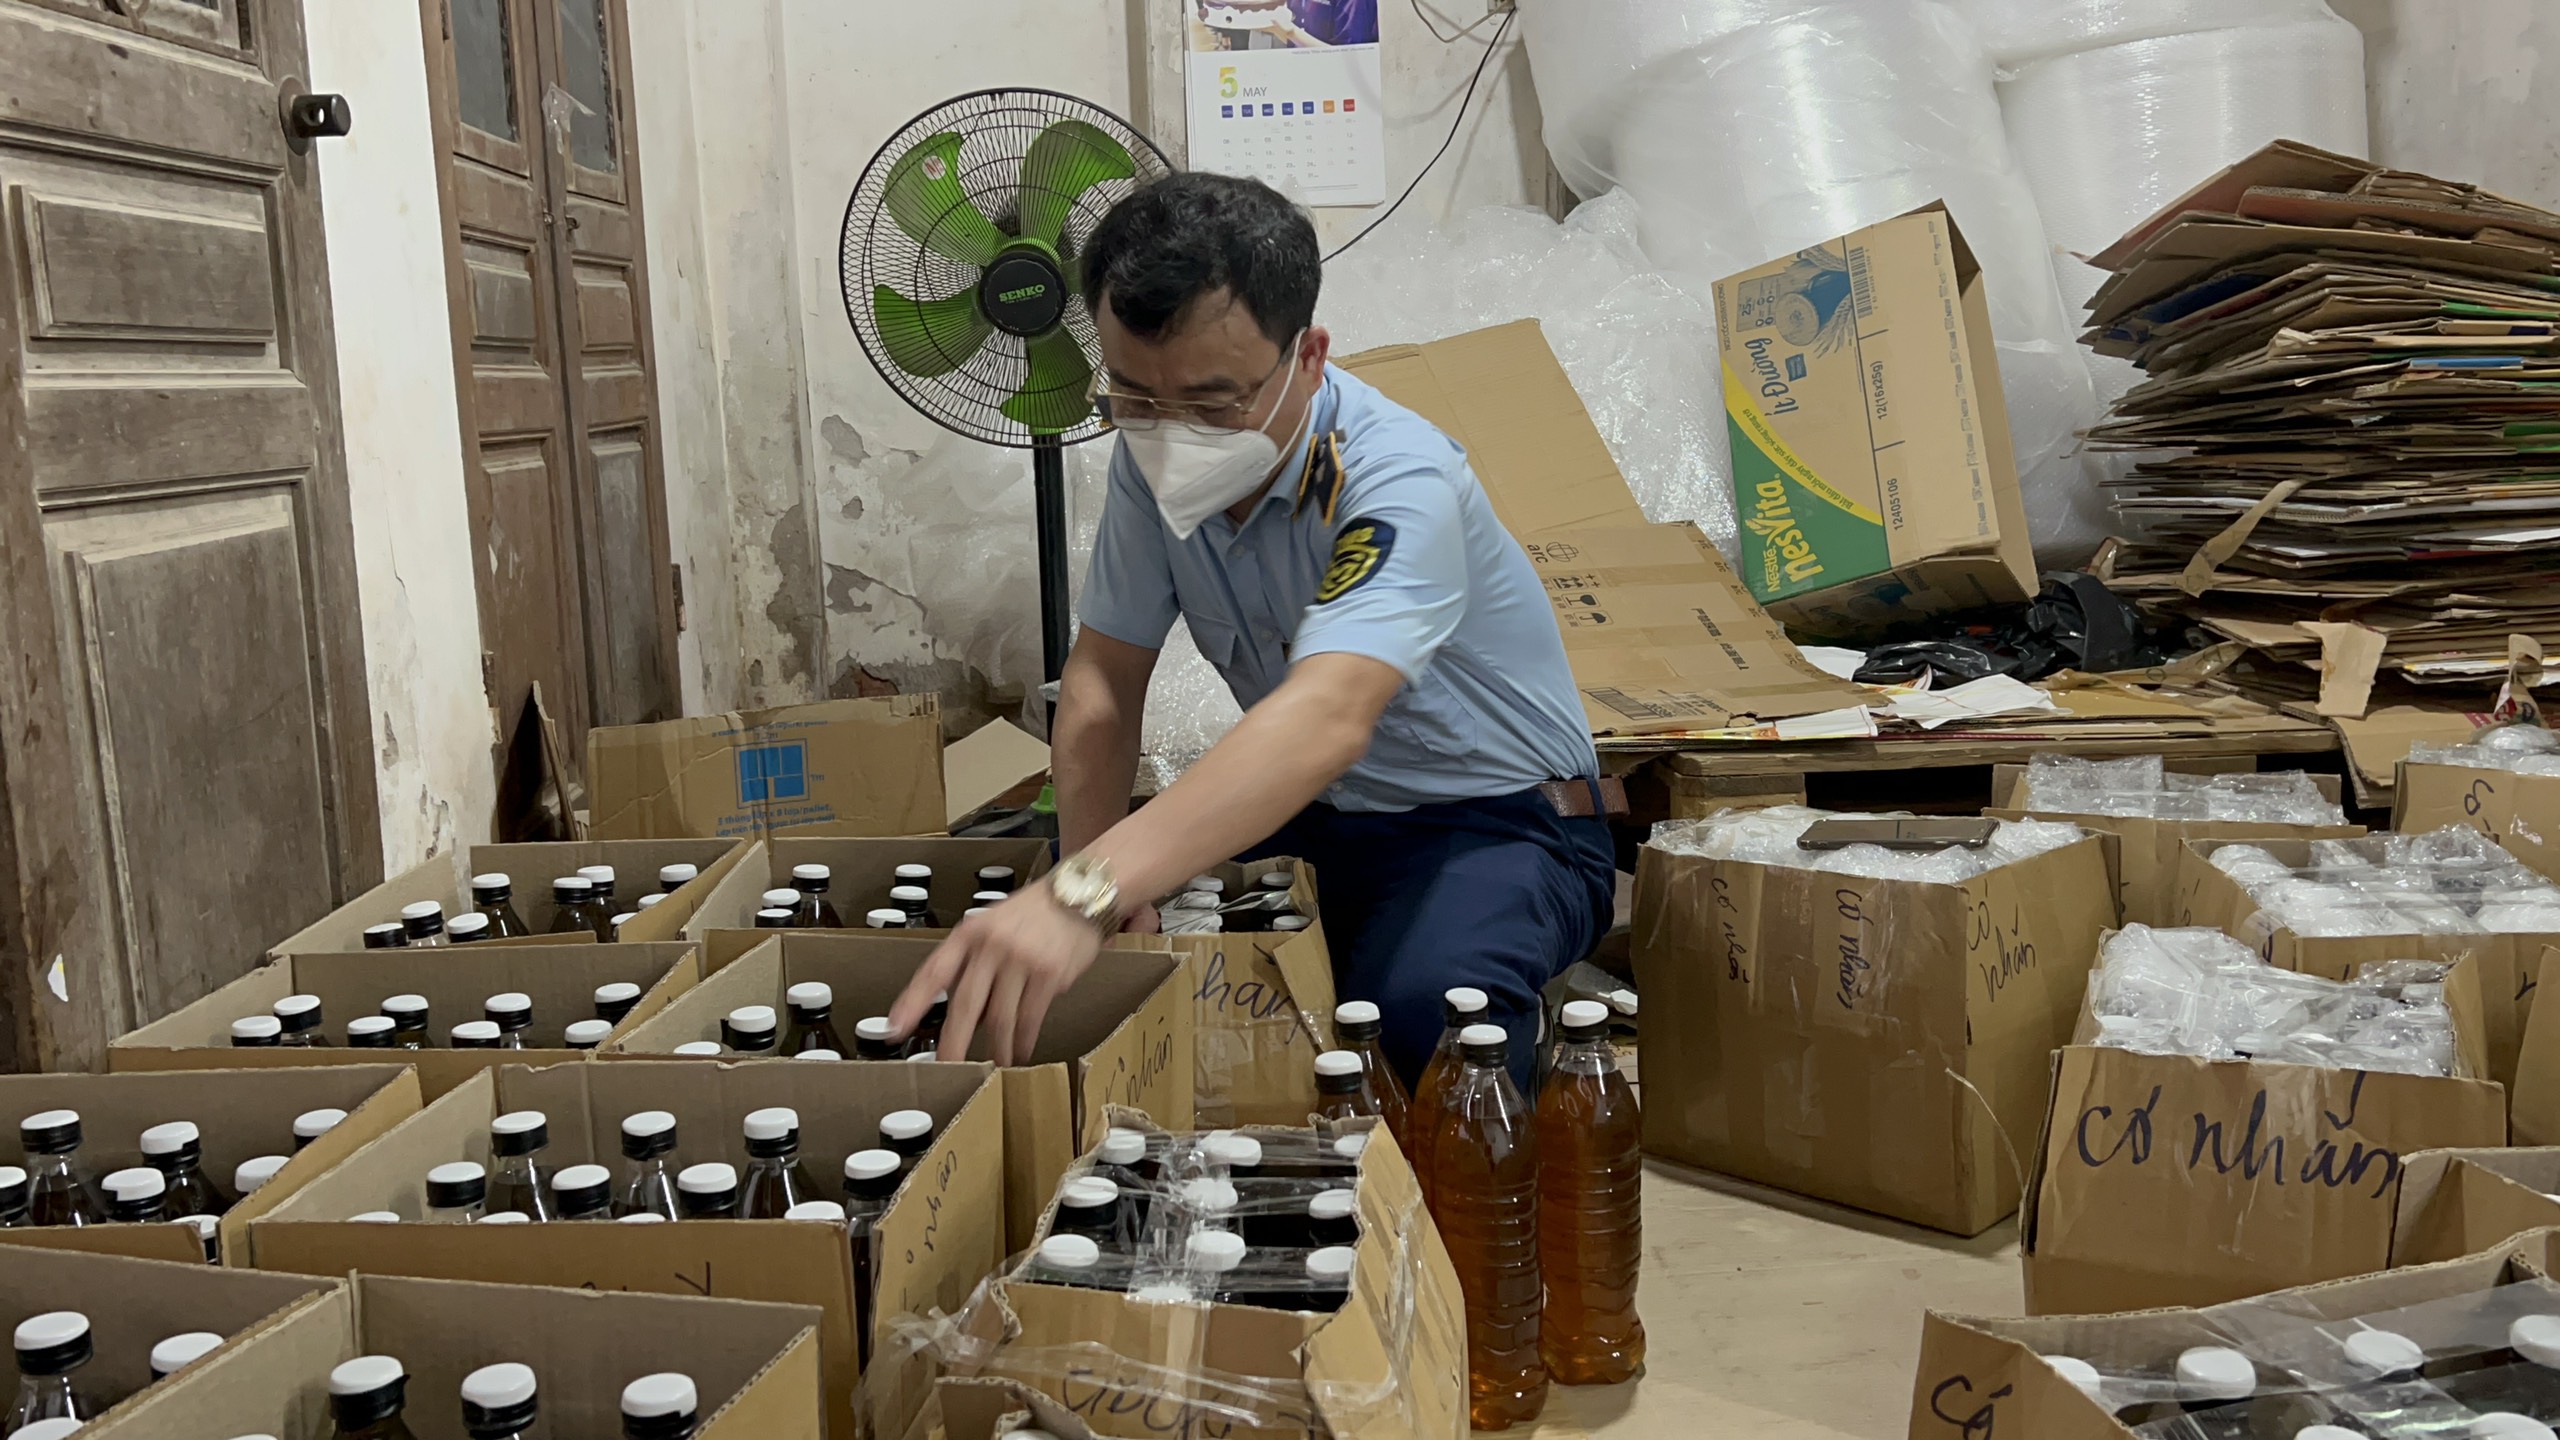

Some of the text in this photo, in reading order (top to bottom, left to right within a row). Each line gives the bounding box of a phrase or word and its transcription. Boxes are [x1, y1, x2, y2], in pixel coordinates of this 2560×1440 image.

[1219, 66, 1268, 98] 5 MAY
[998, 284, 1045, 302] SENKO
[1744, 337, 1790, 398] Đường
[1764, 397, 1799, 416] Ít
[1870, 360, 1888, 420] 12(16x25g)
[1887, 478, 1904, 531] 12405106
[1527, 544, 1549, 564] arc
[1763, 549, 1780, 593] Nestlé
